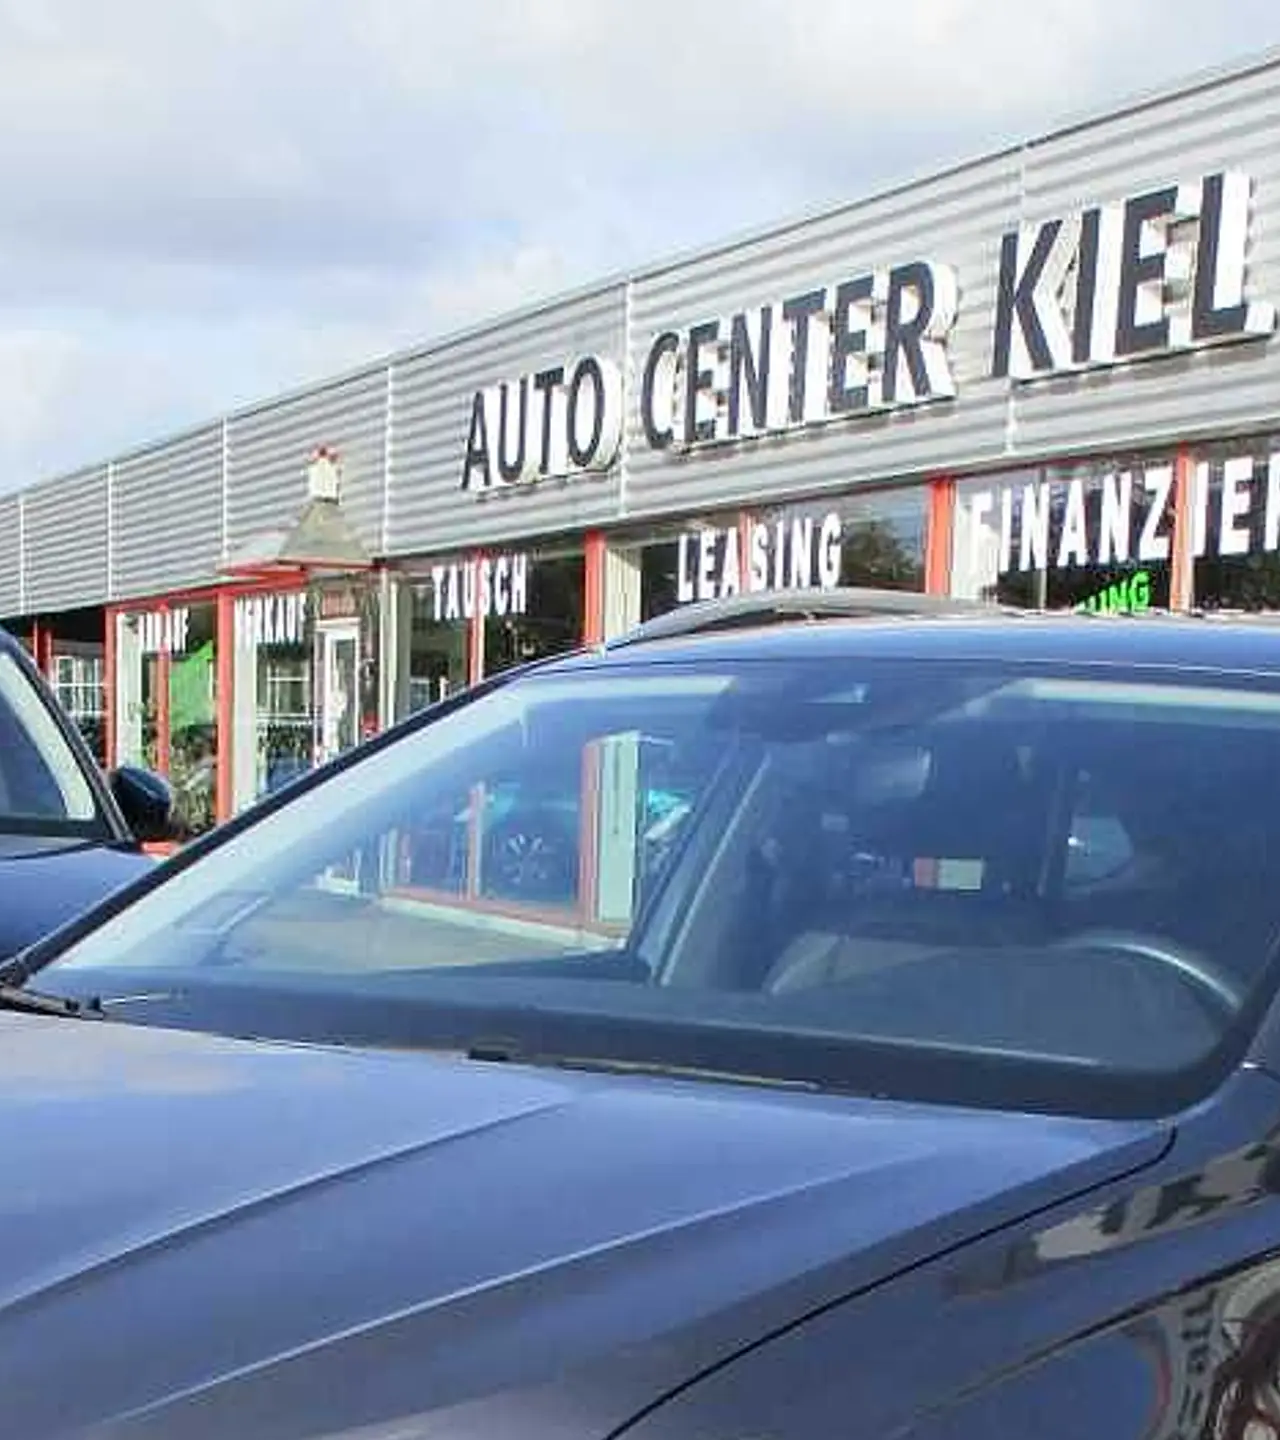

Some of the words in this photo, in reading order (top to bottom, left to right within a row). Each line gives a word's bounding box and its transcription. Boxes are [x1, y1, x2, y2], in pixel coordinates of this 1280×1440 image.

[461, 355, 616, 492] AUTO
[640, 261, 957, 450] CENTER
[991, 168, 1276, 380] KIEL
[433, 553, 528, 621] TAUSCH
[678, 512, 842, 603] LEASING
